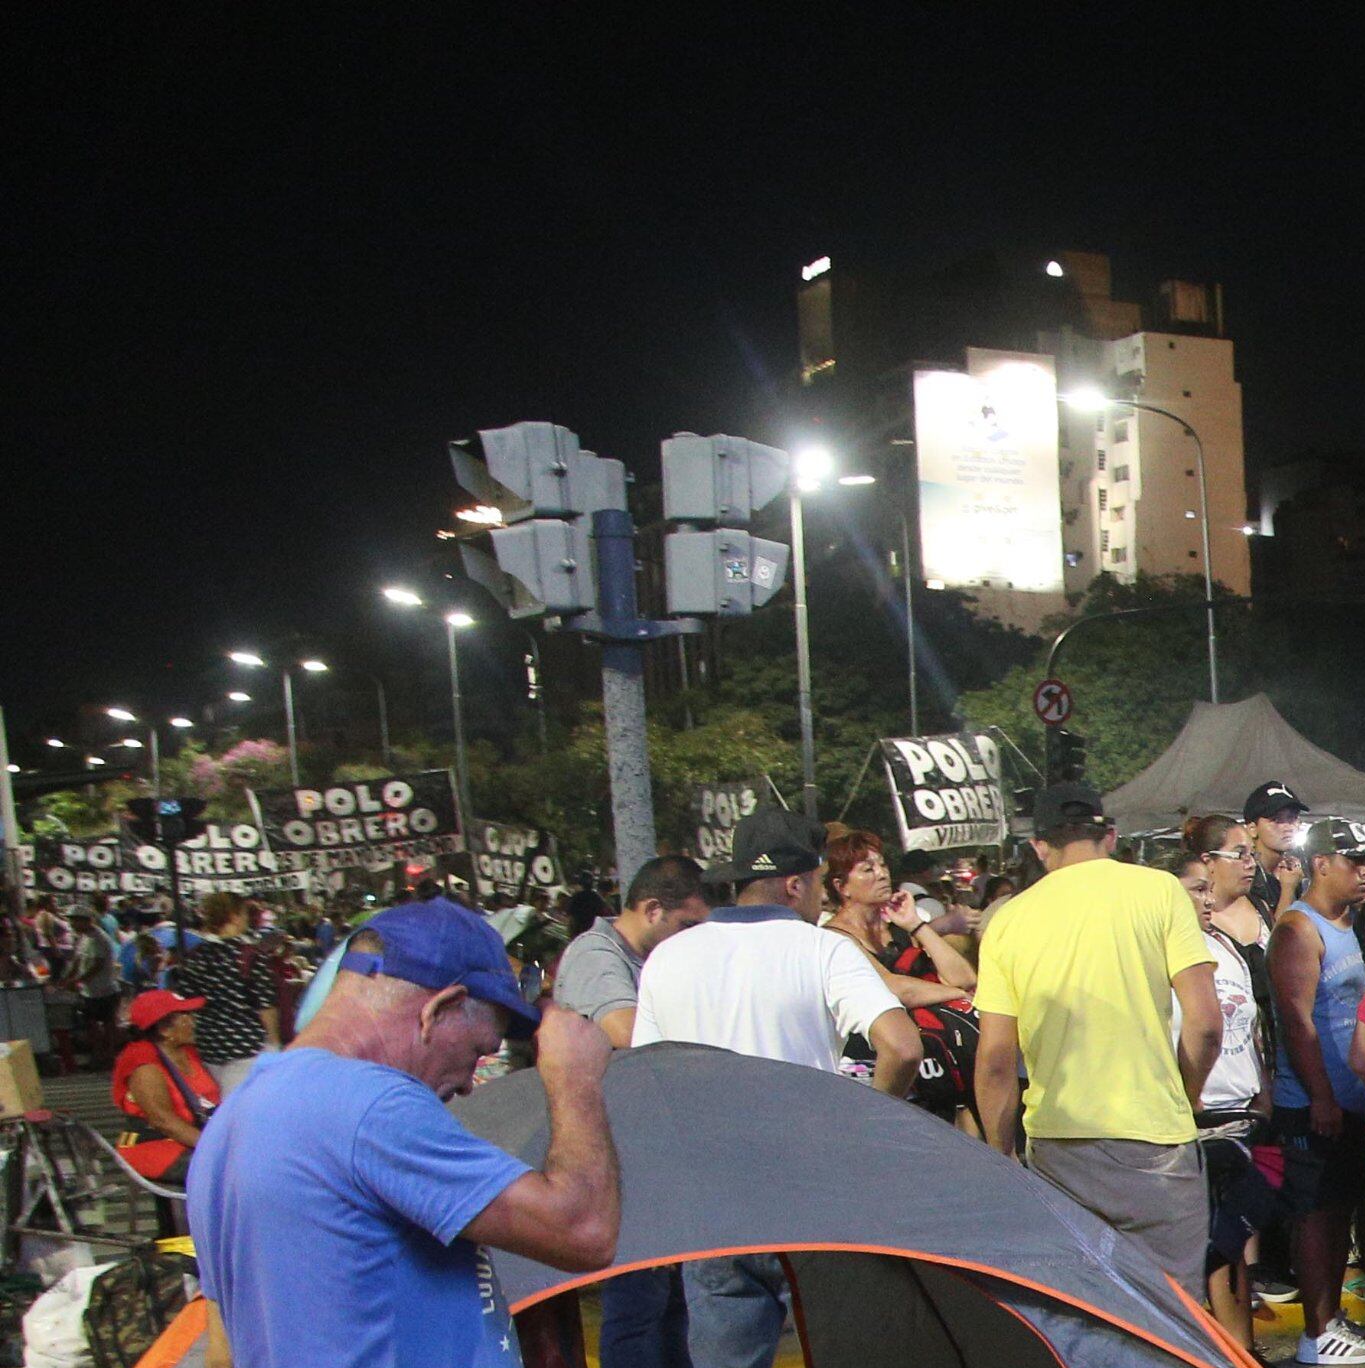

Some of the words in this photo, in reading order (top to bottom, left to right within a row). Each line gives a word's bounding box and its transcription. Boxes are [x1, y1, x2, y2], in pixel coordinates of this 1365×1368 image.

[894, 735, 1000, 785] POLO
[294, 781, 413, 818] POLO
[283, 808, 437, 846] OBRERO
